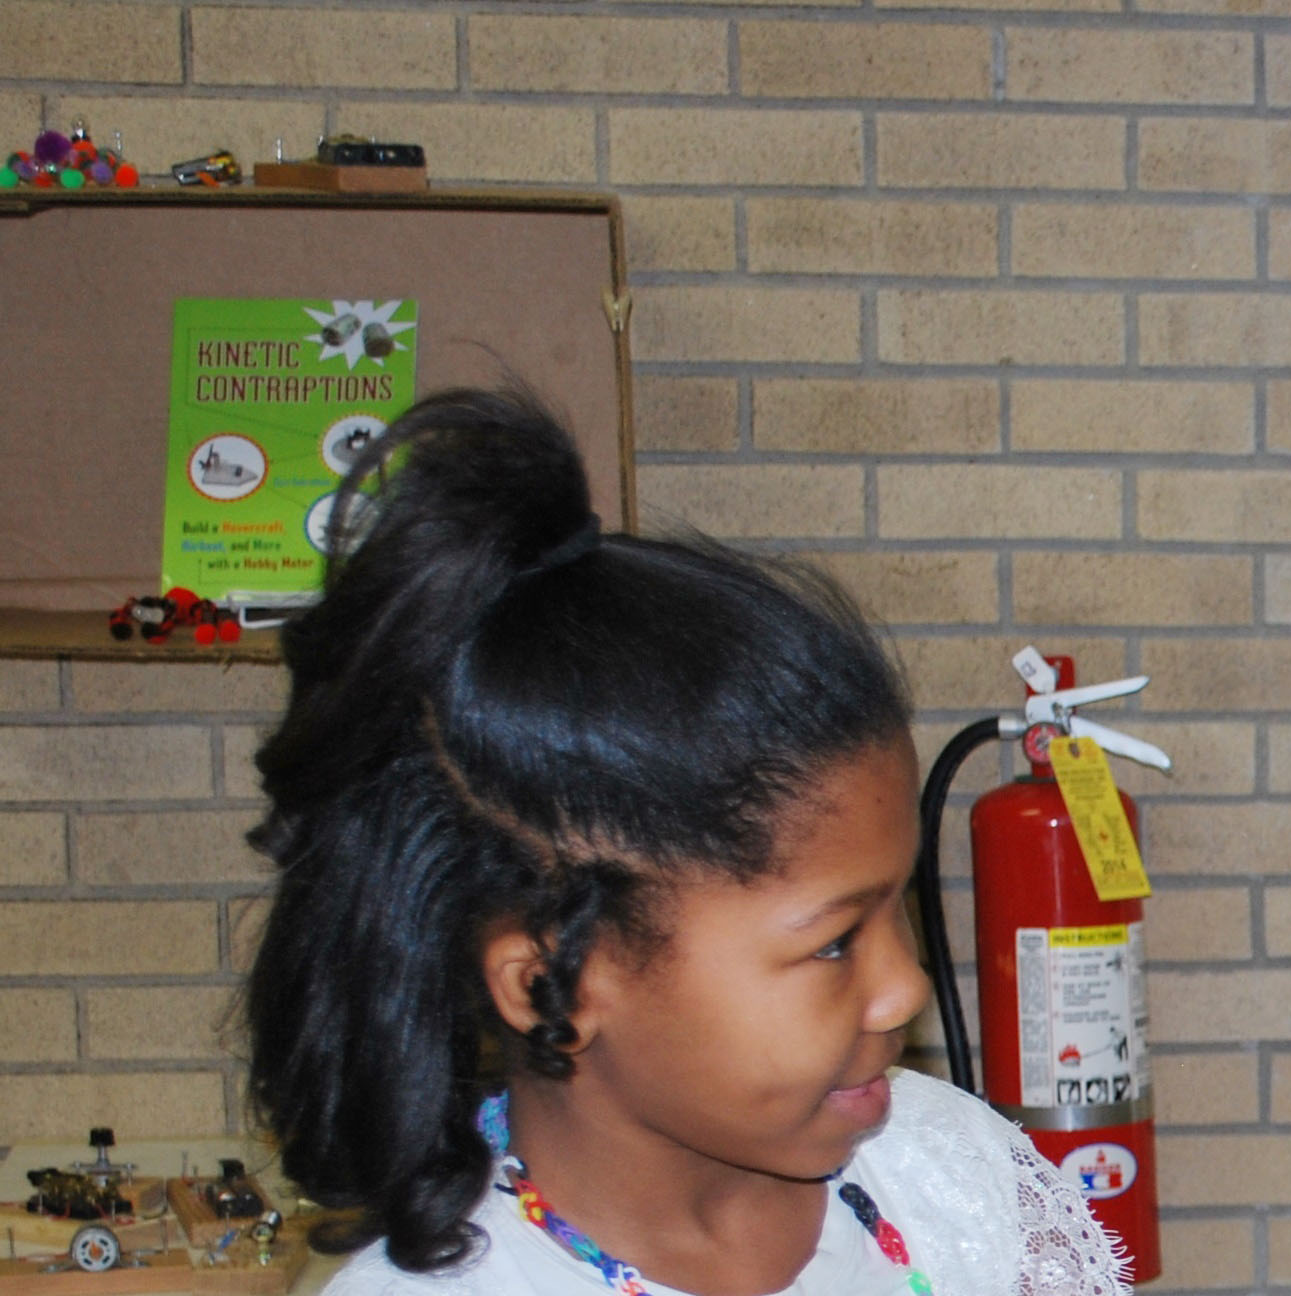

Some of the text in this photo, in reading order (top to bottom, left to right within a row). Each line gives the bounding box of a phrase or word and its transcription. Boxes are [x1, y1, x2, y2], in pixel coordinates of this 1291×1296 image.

[198, 341, 300, 369] KINETIC
[196, 374, 394, 403] CONTRAPTIONS
[182, 521, 209, 534] Build
[230, 540, 250, 551] and
[252, 540, 281, 551] More
[207, 558, 230, 569] with
[243, 557, 278, 572] Hobby
[281, 556, 314, 569] Motor
